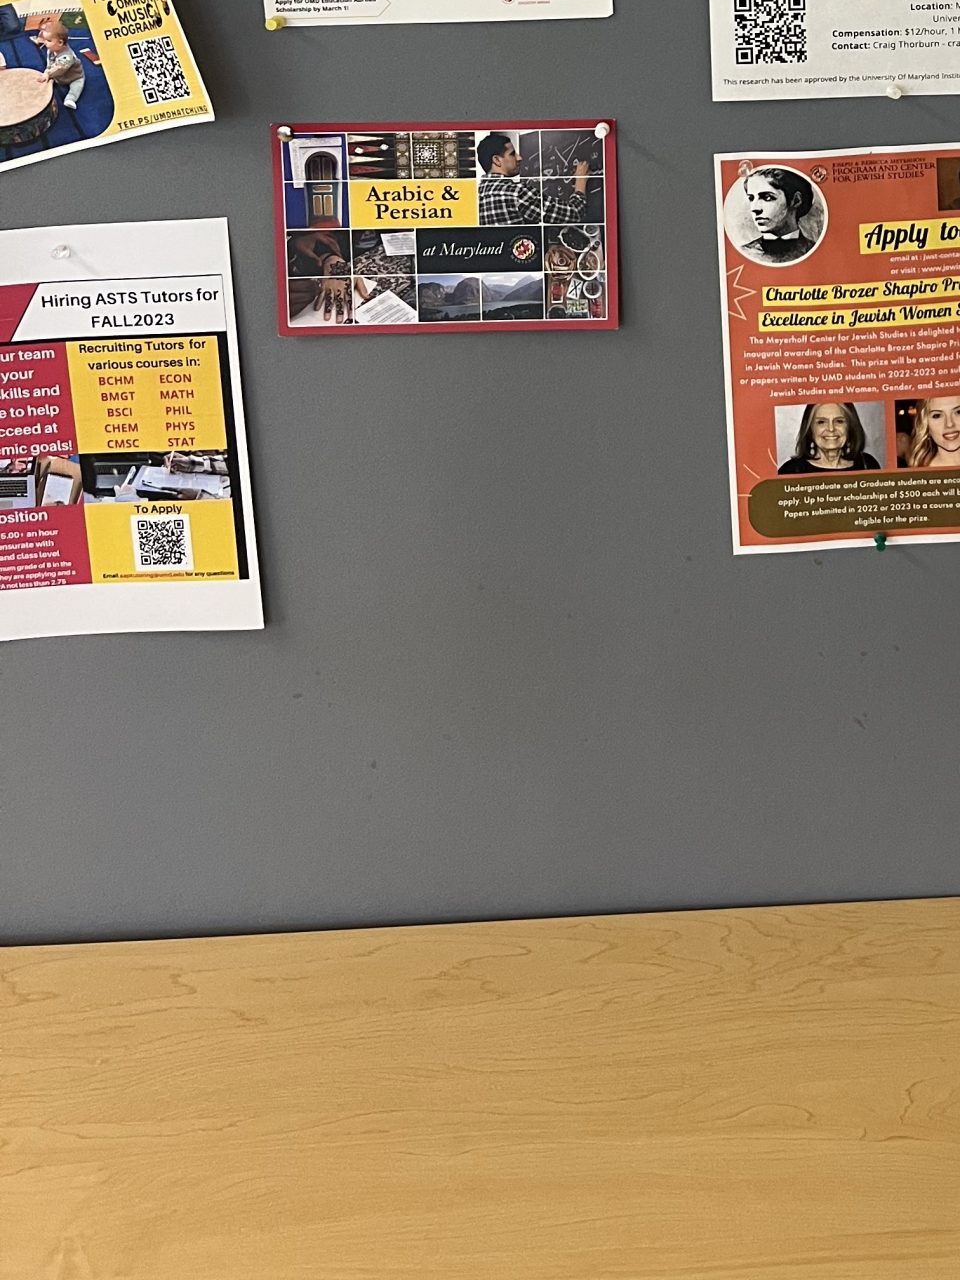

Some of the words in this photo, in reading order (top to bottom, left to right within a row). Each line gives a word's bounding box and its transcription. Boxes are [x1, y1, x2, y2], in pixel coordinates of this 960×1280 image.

[909, 2, 953, 11] Location:
[104, 21, 157, 40] PROGRAM
[364, 184, 434, 202] Arabic
[441, 184, 459, 201] &
[373, 202, 452, 219] Persian
[864, 224, 928, 250] Apply
[422, 245, 436, 256] at
[438, 241, 504, 259] Maryland
[765, 284, 831, 302] Charlotte
[832, 282, 879, 300] Brozer
[883, 278, 938, 298] Shapiro
[41, 293, 91, 309] Hiring
[95, 290, 137, 305] ASTS
[139, 290, 193, 303] Tutors
[195, 287, 219, 301] for
[91, 312, 174, 328] FALL2023
[761, 311, 829, 328] Excellence
[831, 309, 845, 325] in
[848, 307, 896, 328] Jewish
[899, 304, 955, 321] Women
[78, 341, 142, 354] Recruiting
[143, 340, 184, 351] Tutors
[188, 338, 206, 349] for
[87, 358, 133, 370] various
[135, 358, 183, 368] courses
[185, 356, 200, 366] in:
[98, 375, 134, 386] BCHM
[159, 373, 191, 384] ECON
[100, 390, 135, 402] BMGT
[159, 388, 194, 400] MATH
[106, 407, 132, 417] BSCI
[165, 405, 192, 415] PHIL
[103, 422, 138, 433] CHEM
[165, 420, 195, 431] PHYS
[106, 438, 139, 449] CMSC
[167, 436, 195, 447] STAT
[133, 504, 148, 514] To
[150, 503, 182, 515] Apply
